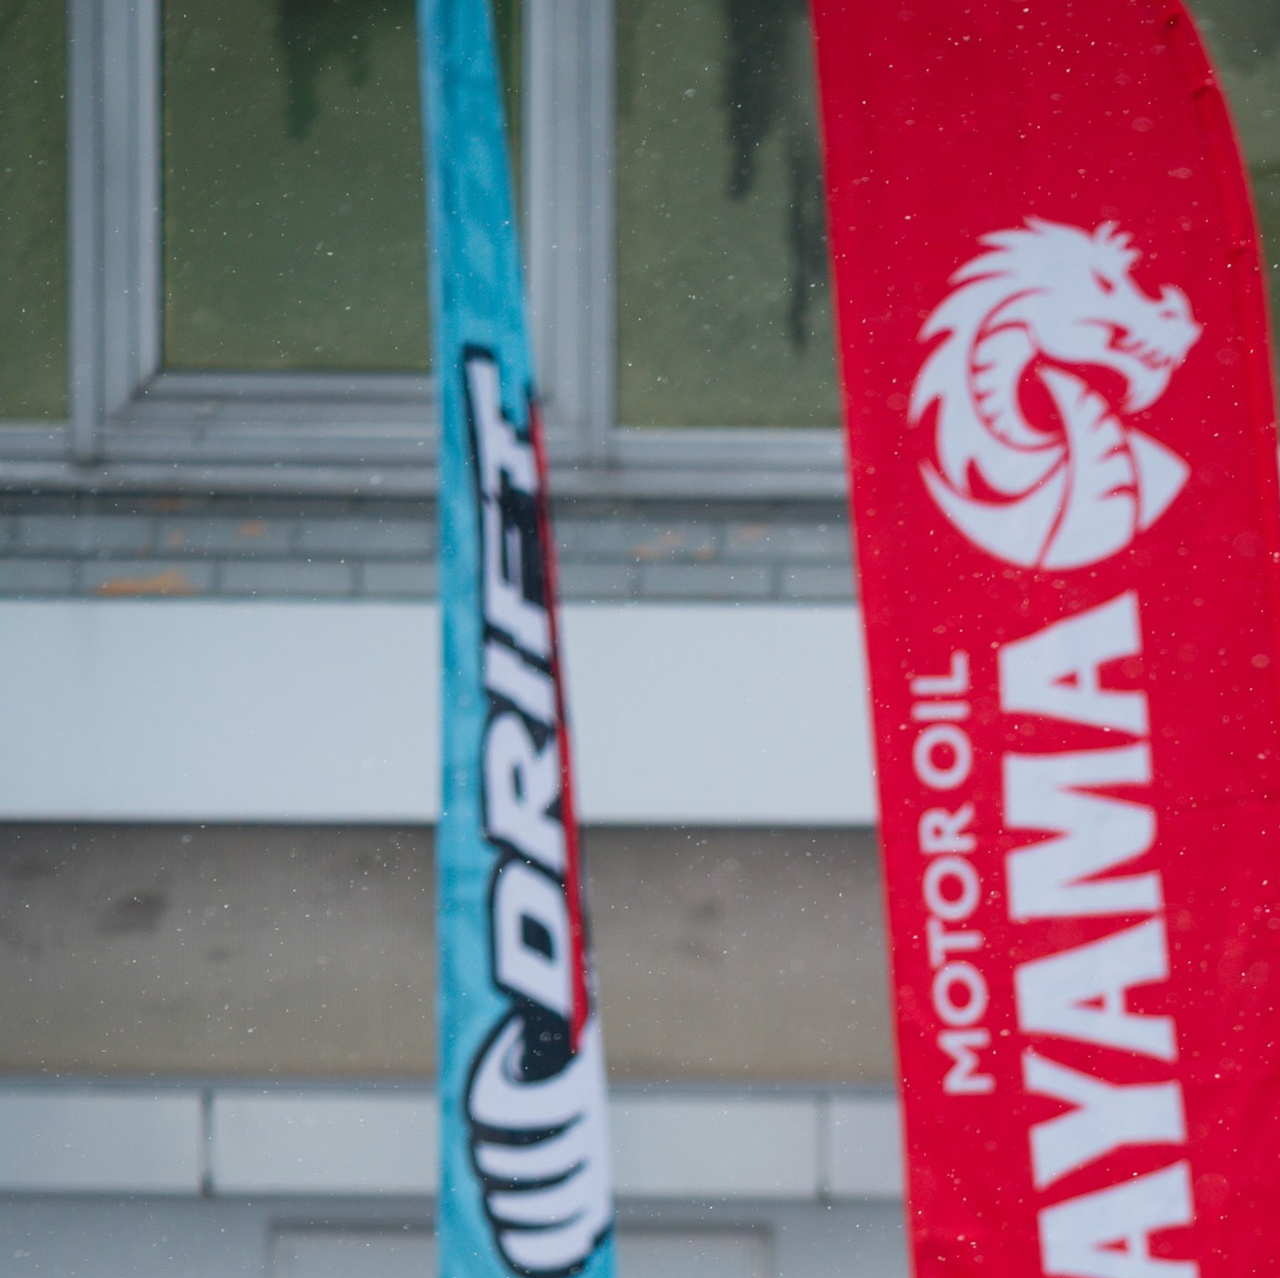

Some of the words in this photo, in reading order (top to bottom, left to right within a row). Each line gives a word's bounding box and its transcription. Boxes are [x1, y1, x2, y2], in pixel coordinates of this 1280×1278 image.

[466, 355, 574, 1020] DRIFT
[911, 650, 972, 794] OIL
[917, 803, 996, 1095] MOTOR
